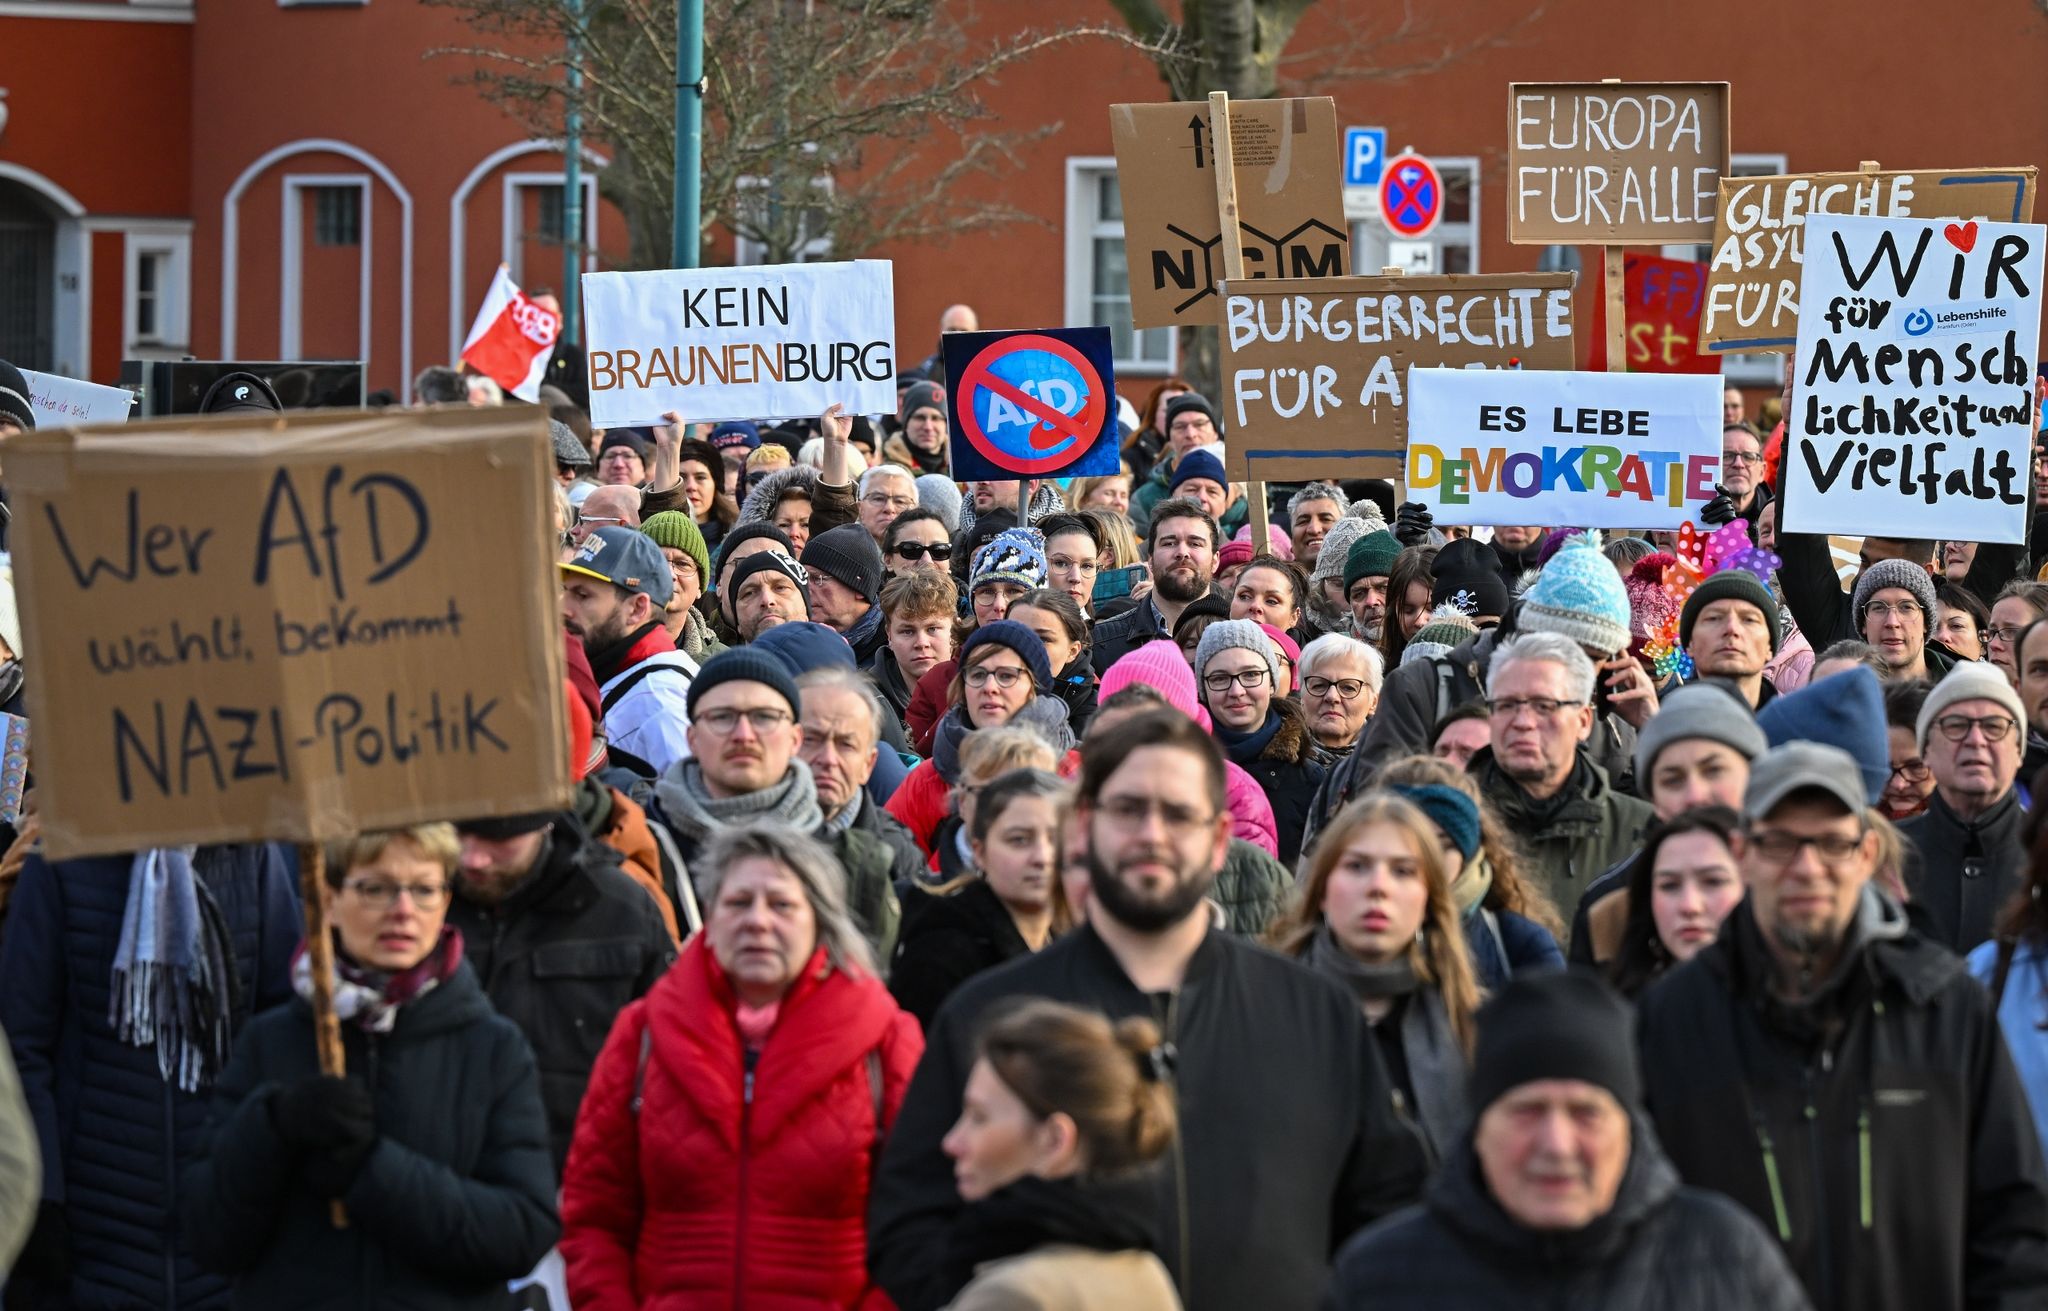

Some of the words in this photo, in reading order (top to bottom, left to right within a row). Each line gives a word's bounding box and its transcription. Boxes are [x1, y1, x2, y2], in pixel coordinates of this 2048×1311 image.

[1516, 94, 1701, 154] EUROPA
[1352, 134, 1377, 181] P
[1518, 165, 1612, 226] FÜR
[1618, 165, 1718, 225] ALLE
[1725, 174, 1915, 234] GLEICHE
[682, 285, 789, 329] KEIN
[1705, 279, 1800, 334] FÜR
[1823, 296, 1892, 335] für
[1936, 306, 2007, 323] Lebenshilfe
[589, 341, 893, 391] BRAUNENBURG
[1804, 329, 2028, 389] Mensch
[1233, 364, 1343, 427] FÜR
[1478, 404, 1527, 433] ES
[1552, 406, 1650, 437] LEBE
[1979, 390, 2032, 427] und
[1407, 443, 1720, 509] DEMOKRATIE
[1799, 437, 2026, 505] Vielfalt
[44, 488, 214, 591] Wer
[252, 465, 430, 600] AfD
